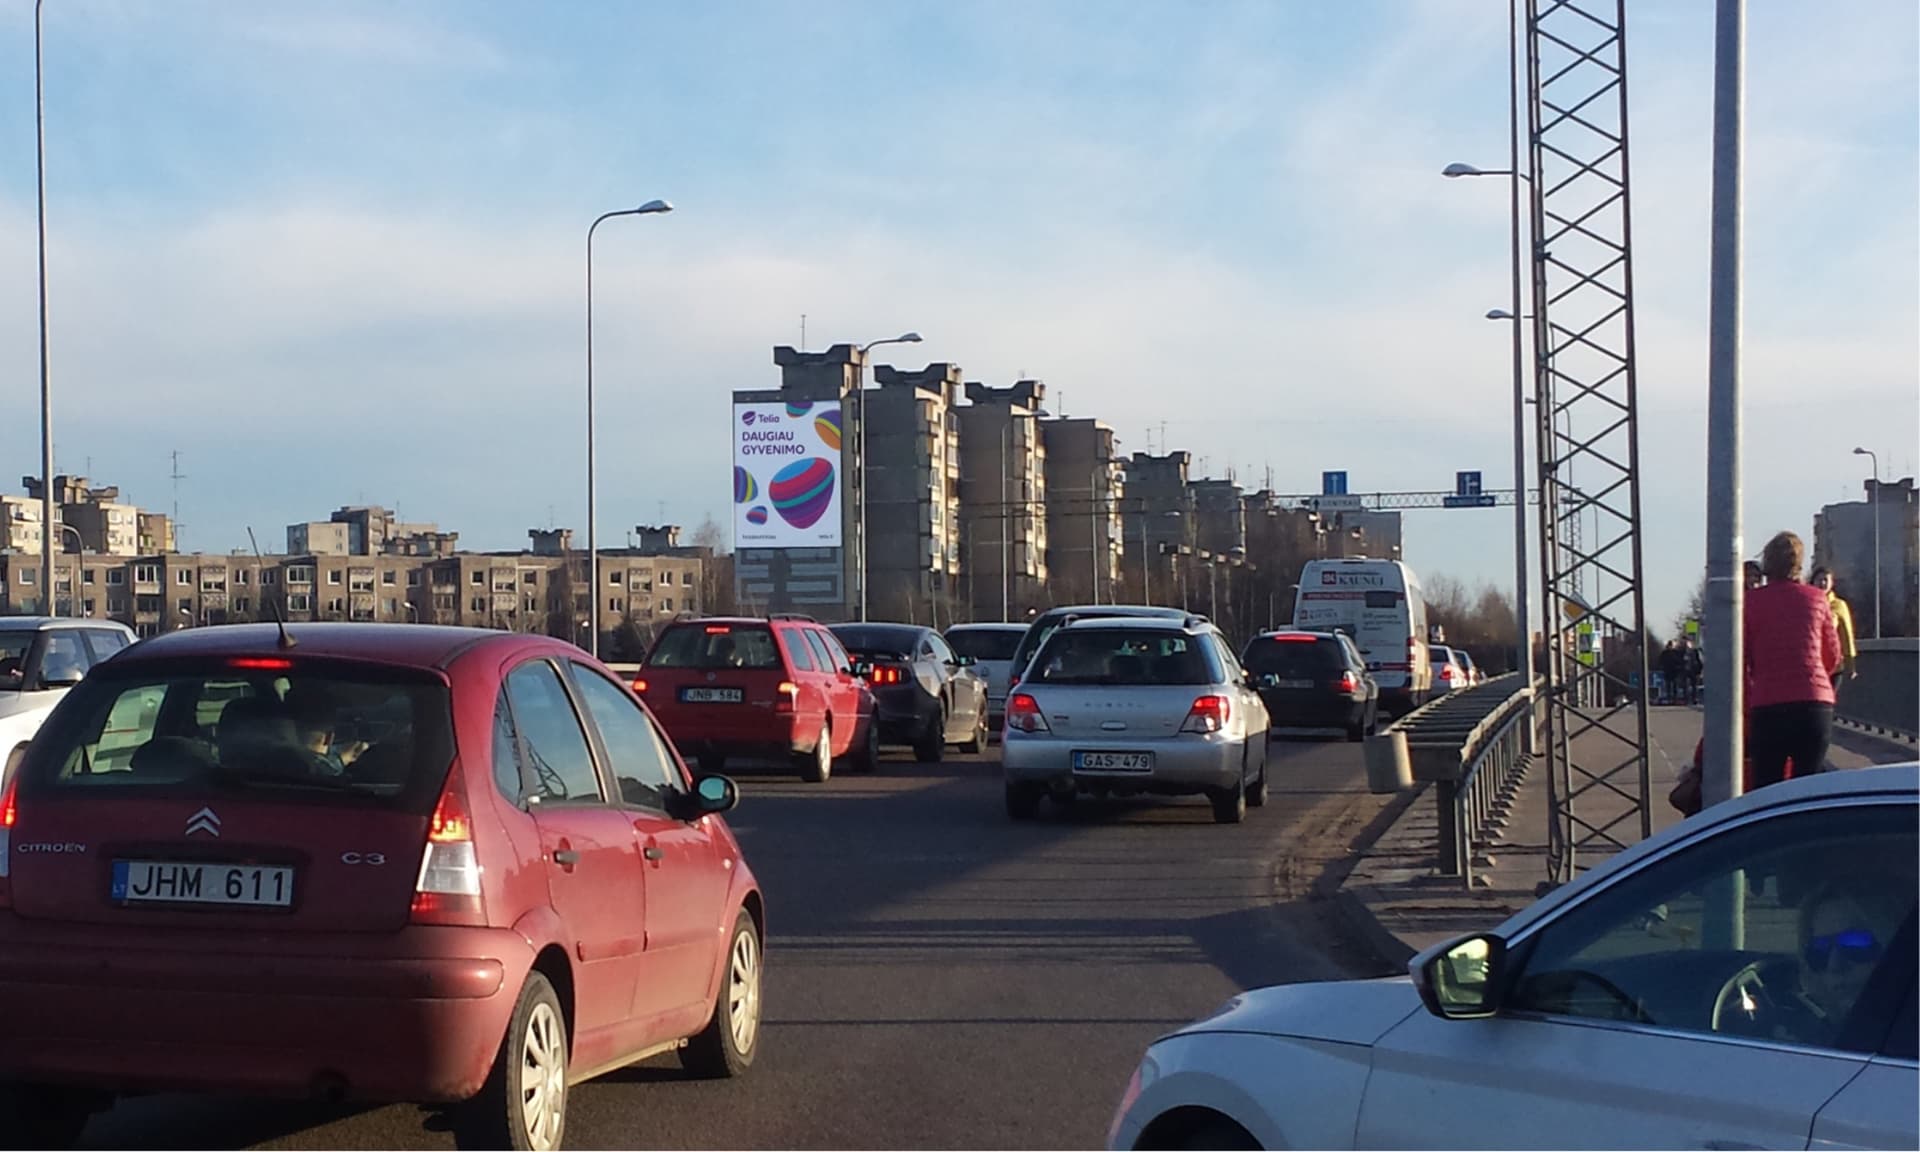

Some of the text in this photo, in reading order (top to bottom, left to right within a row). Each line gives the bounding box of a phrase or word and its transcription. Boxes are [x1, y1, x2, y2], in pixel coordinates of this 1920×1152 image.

[758, 414, 780, 423] Telia
[742, 431, 794, 441] DAUGIAU
[742, 444, 805, 455] GYVENIMO
[1083, 755, 1149, 768] GAS 479
[341, 852, 385, 865] C3
[132, 866, 284, 901] JHM 611
